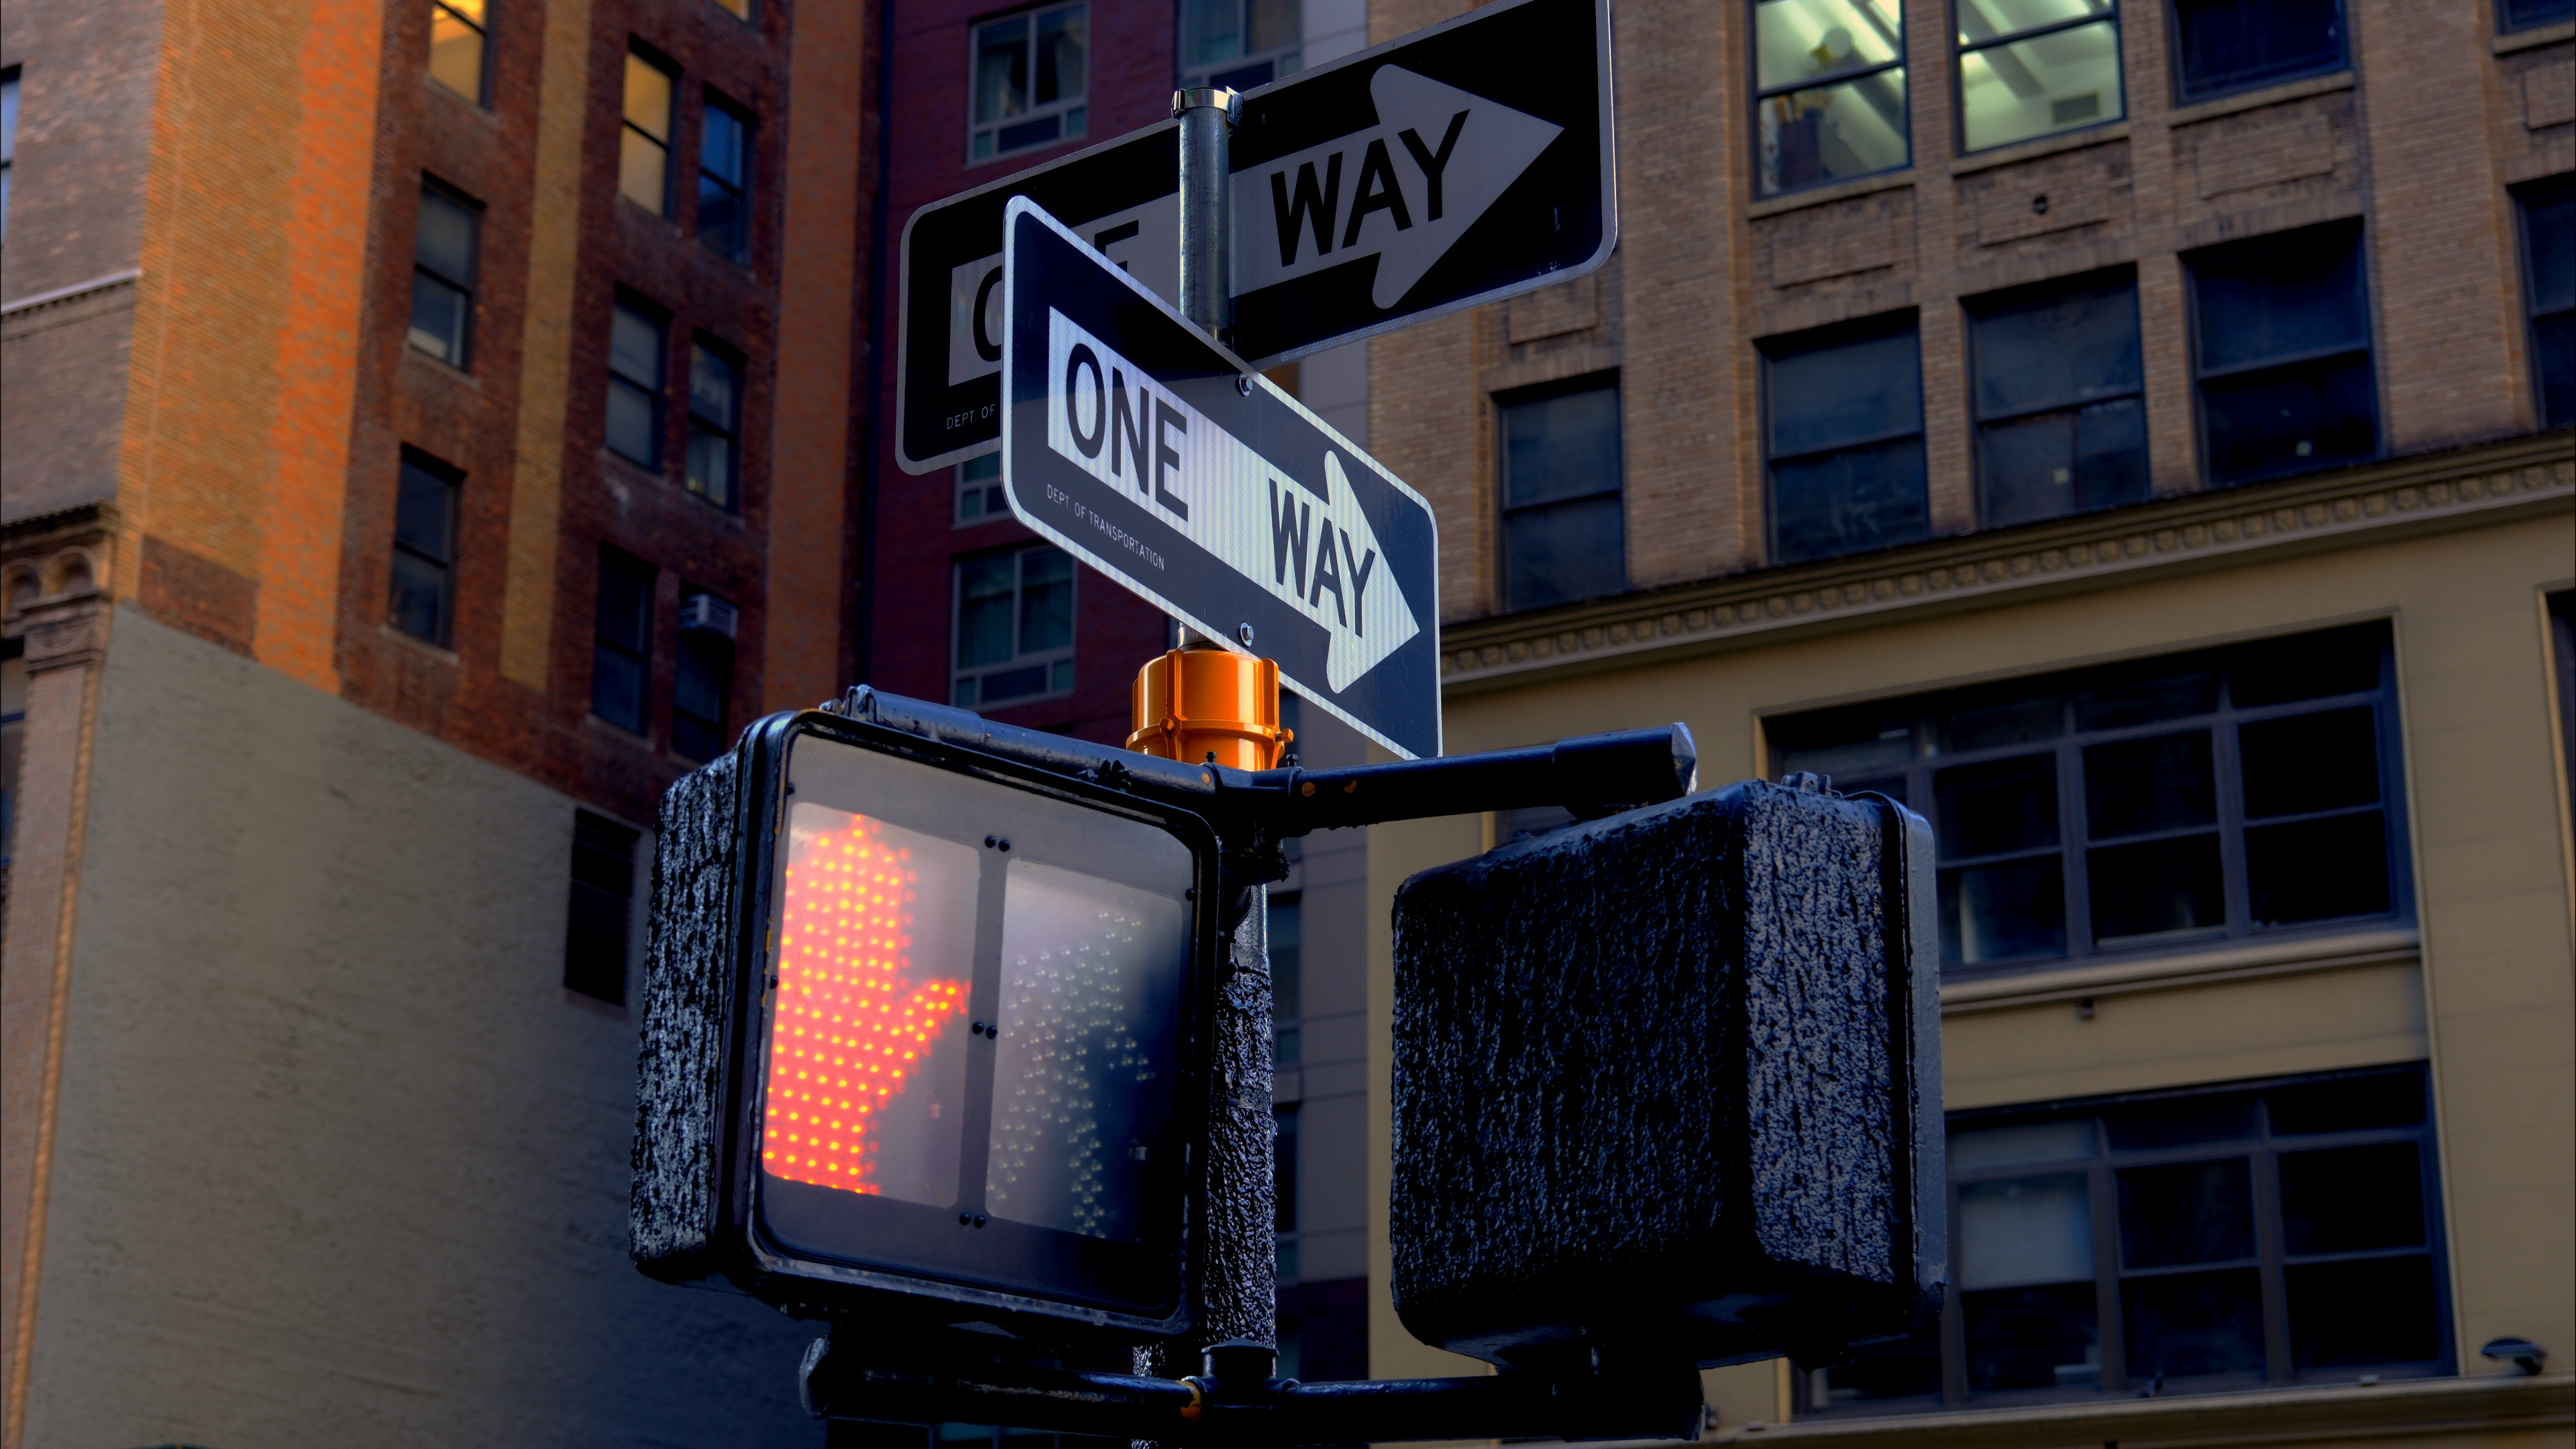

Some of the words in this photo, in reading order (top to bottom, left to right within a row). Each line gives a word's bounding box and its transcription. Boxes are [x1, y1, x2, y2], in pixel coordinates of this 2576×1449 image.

[1270, 109, 1470, 268] WAY
[947, 410, 977, 430] DEPT.
[981, 403, 996, 419] OF
[1046, 483, 1072, 513] DEPT.
[1074, 502, 1086, 519] OF
[1089, 510, 1165, 572] TRANSPORTATION
[1065, 342, 1189, 523] ONE
[1268, 477, 1376, 639] WAY
